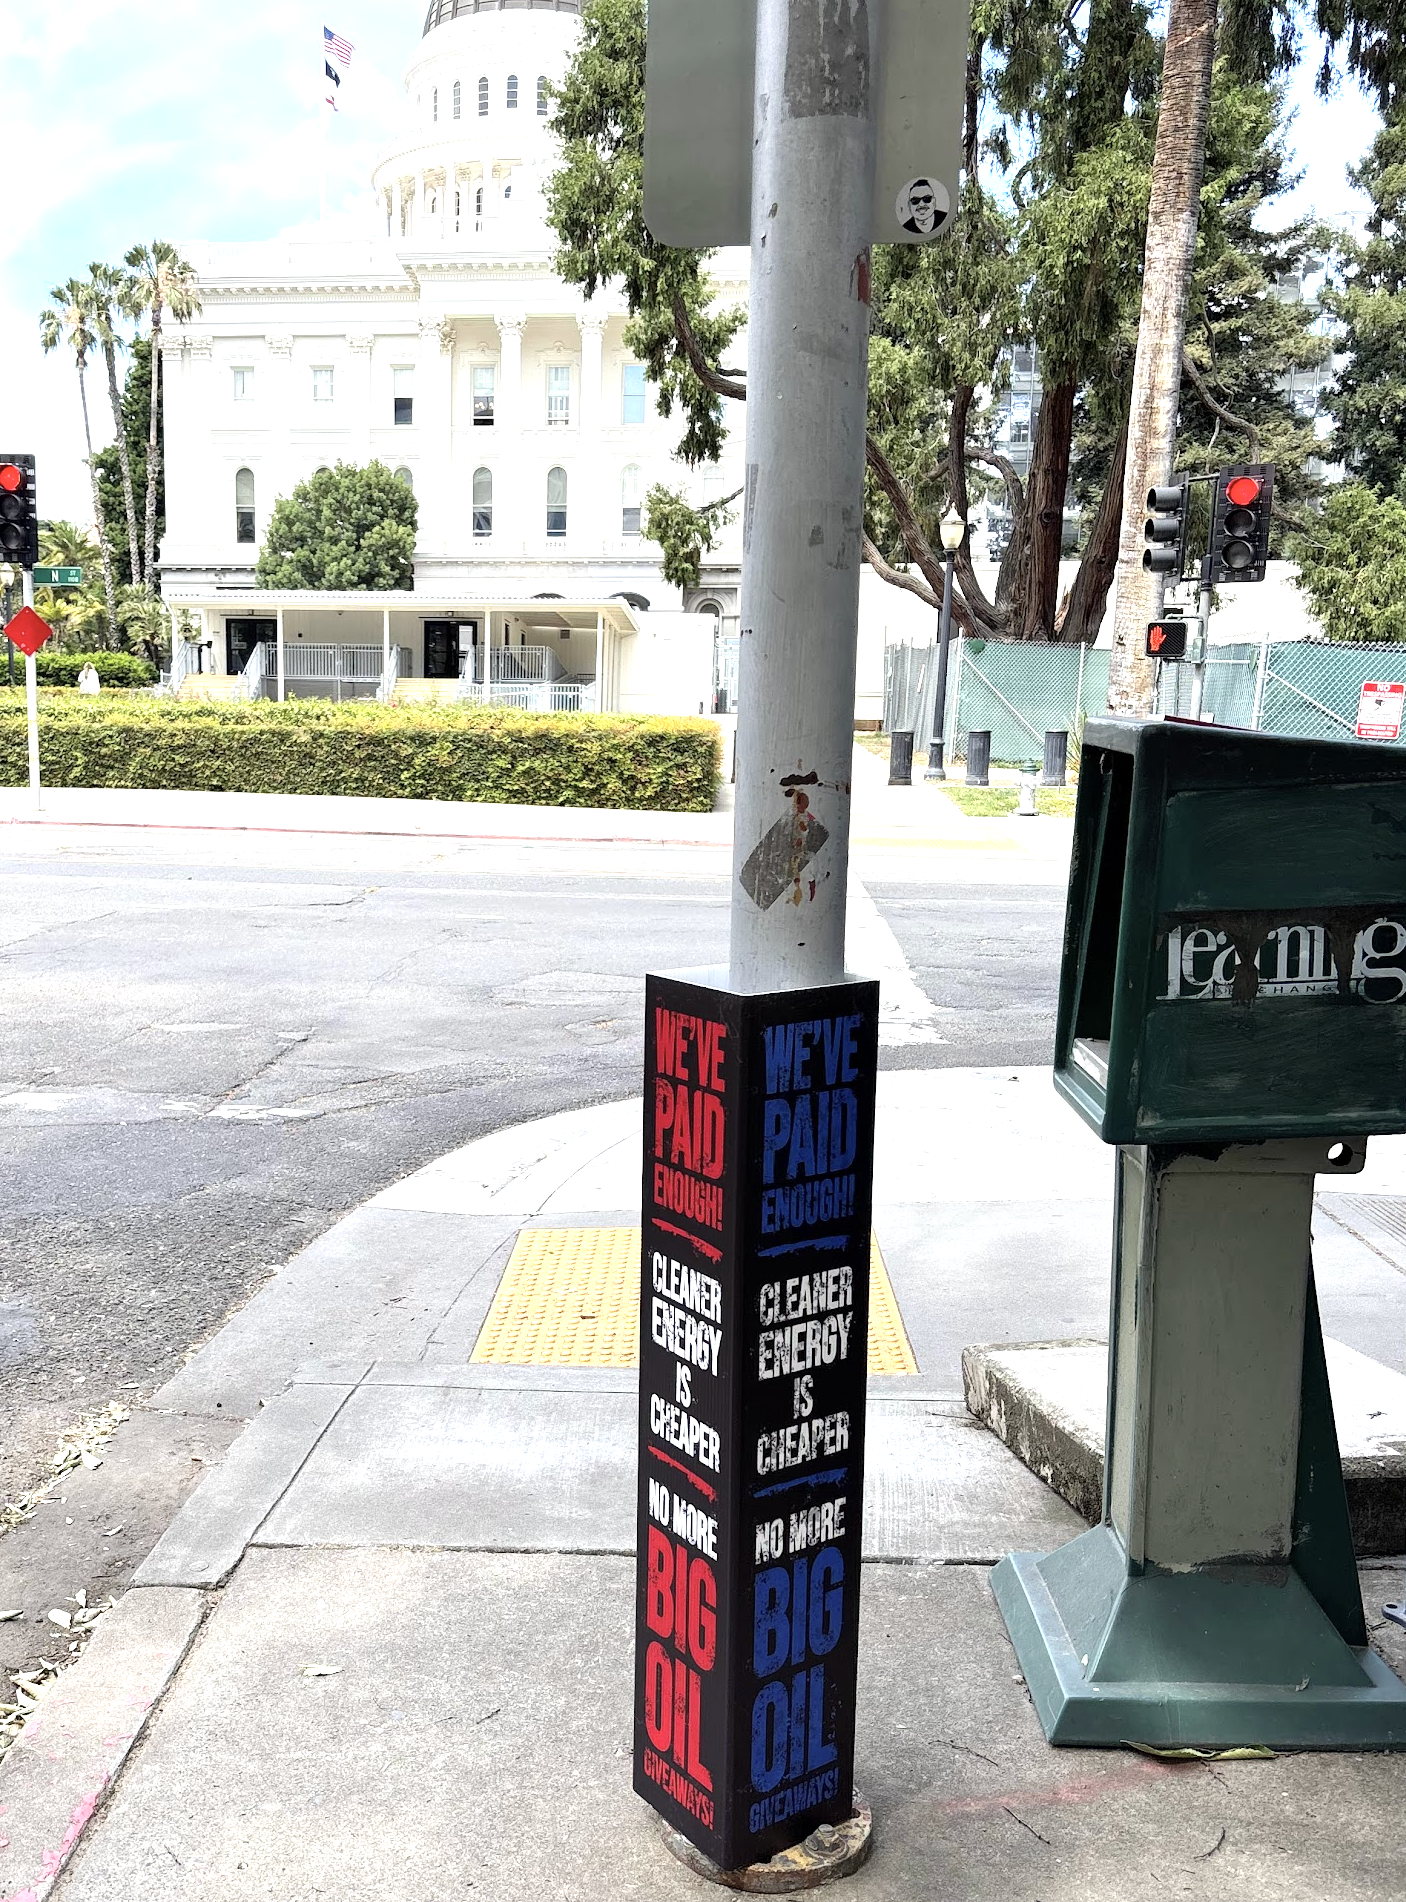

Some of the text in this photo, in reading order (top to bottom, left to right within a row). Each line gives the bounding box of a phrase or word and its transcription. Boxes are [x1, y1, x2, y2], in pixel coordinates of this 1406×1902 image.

[51, 570, 59, 582] N
[655, 1007, 727, 1092] WE'VE
[763, 1014, 861, 1094] WE'VE
[654, 1076, 725, 1180] PAID
[762, 1087, 857, 1185] PAID
[653, 1162, 723, 1231] ENOUGH!
[761, 1174, 855, 1234] ENOUGH!
[652, 1251, 722, 1324] CLEANER
[759, 1266, 853, 1326] CLEANER
[651, 1296, 723, 1377] ENERGY
[758, 1311, 853, 1381] ENERGY
[675, 1361, 692, 1408] IS
[793, 1374, 814, 1419] IS
[650, 1393, 720, 1473] CHEAPER
[757, 1411, 850, 1475] CHEAPER
[649, 1477, 718, 1561] NO MORE
[755, 1497, 846, 1565] NO MORE
[646, 1524, 717, 1671] BIG
[753, 1546, 845, 1678] BIG
[645, 1641, 713, 1792] OIL
[751, 1663, 838, 1793] OIL
[644, 1747, 714, 1830] GIVEAWAYS!
[749, 1767, 839, 1833] GIVEAWAYS!
